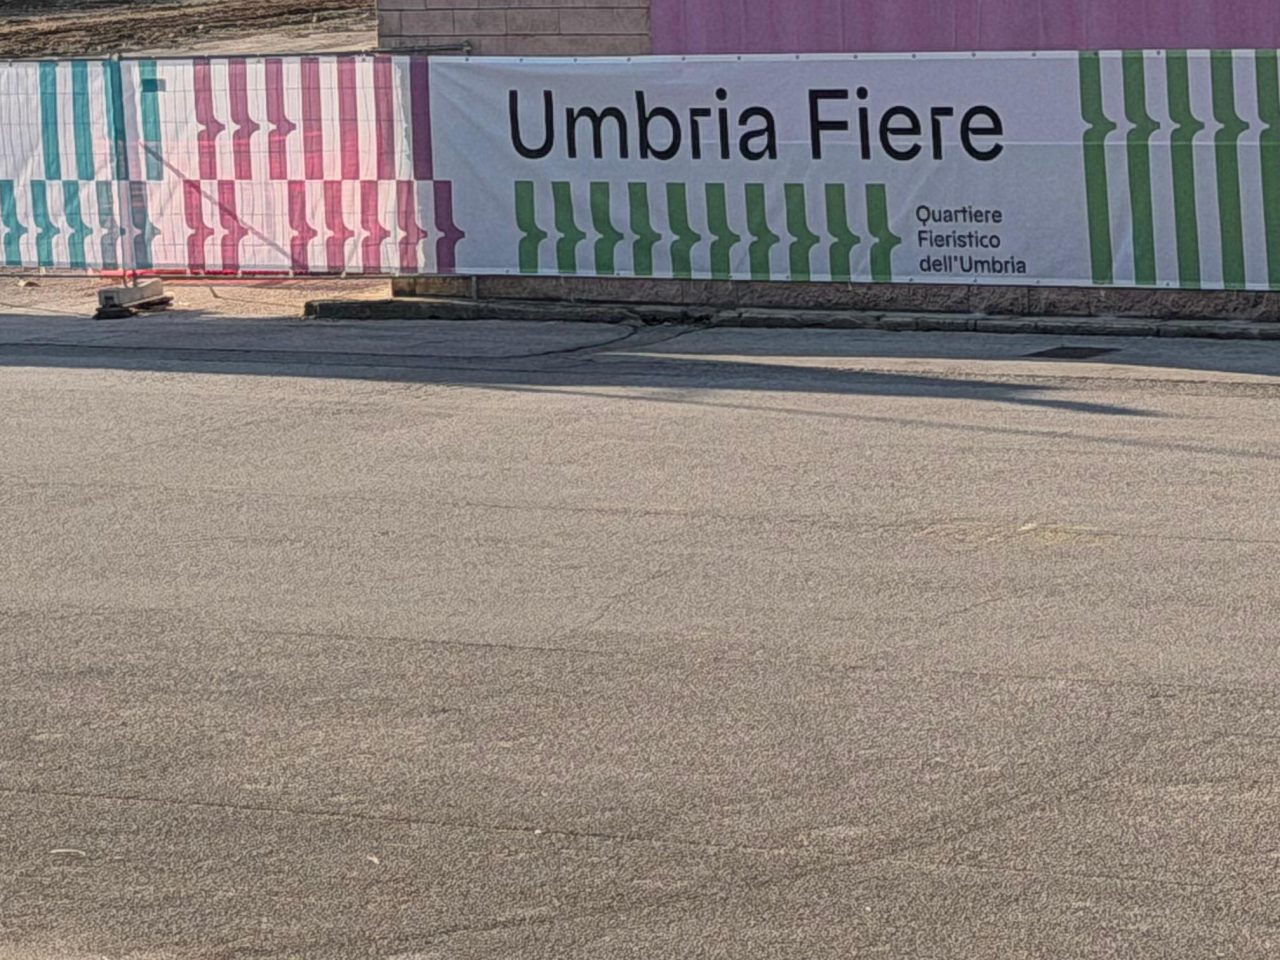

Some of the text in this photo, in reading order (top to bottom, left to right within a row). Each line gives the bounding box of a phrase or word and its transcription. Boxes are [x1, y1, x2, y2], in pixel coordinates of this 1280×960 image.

[508, 86, 1005, 162] Umbria Fiere
[915, 205, 1003, 227] Quartiere
[918, 229, 1001, 249] Fieristico
[919, 254, 1027, 274] dell'Umbria
